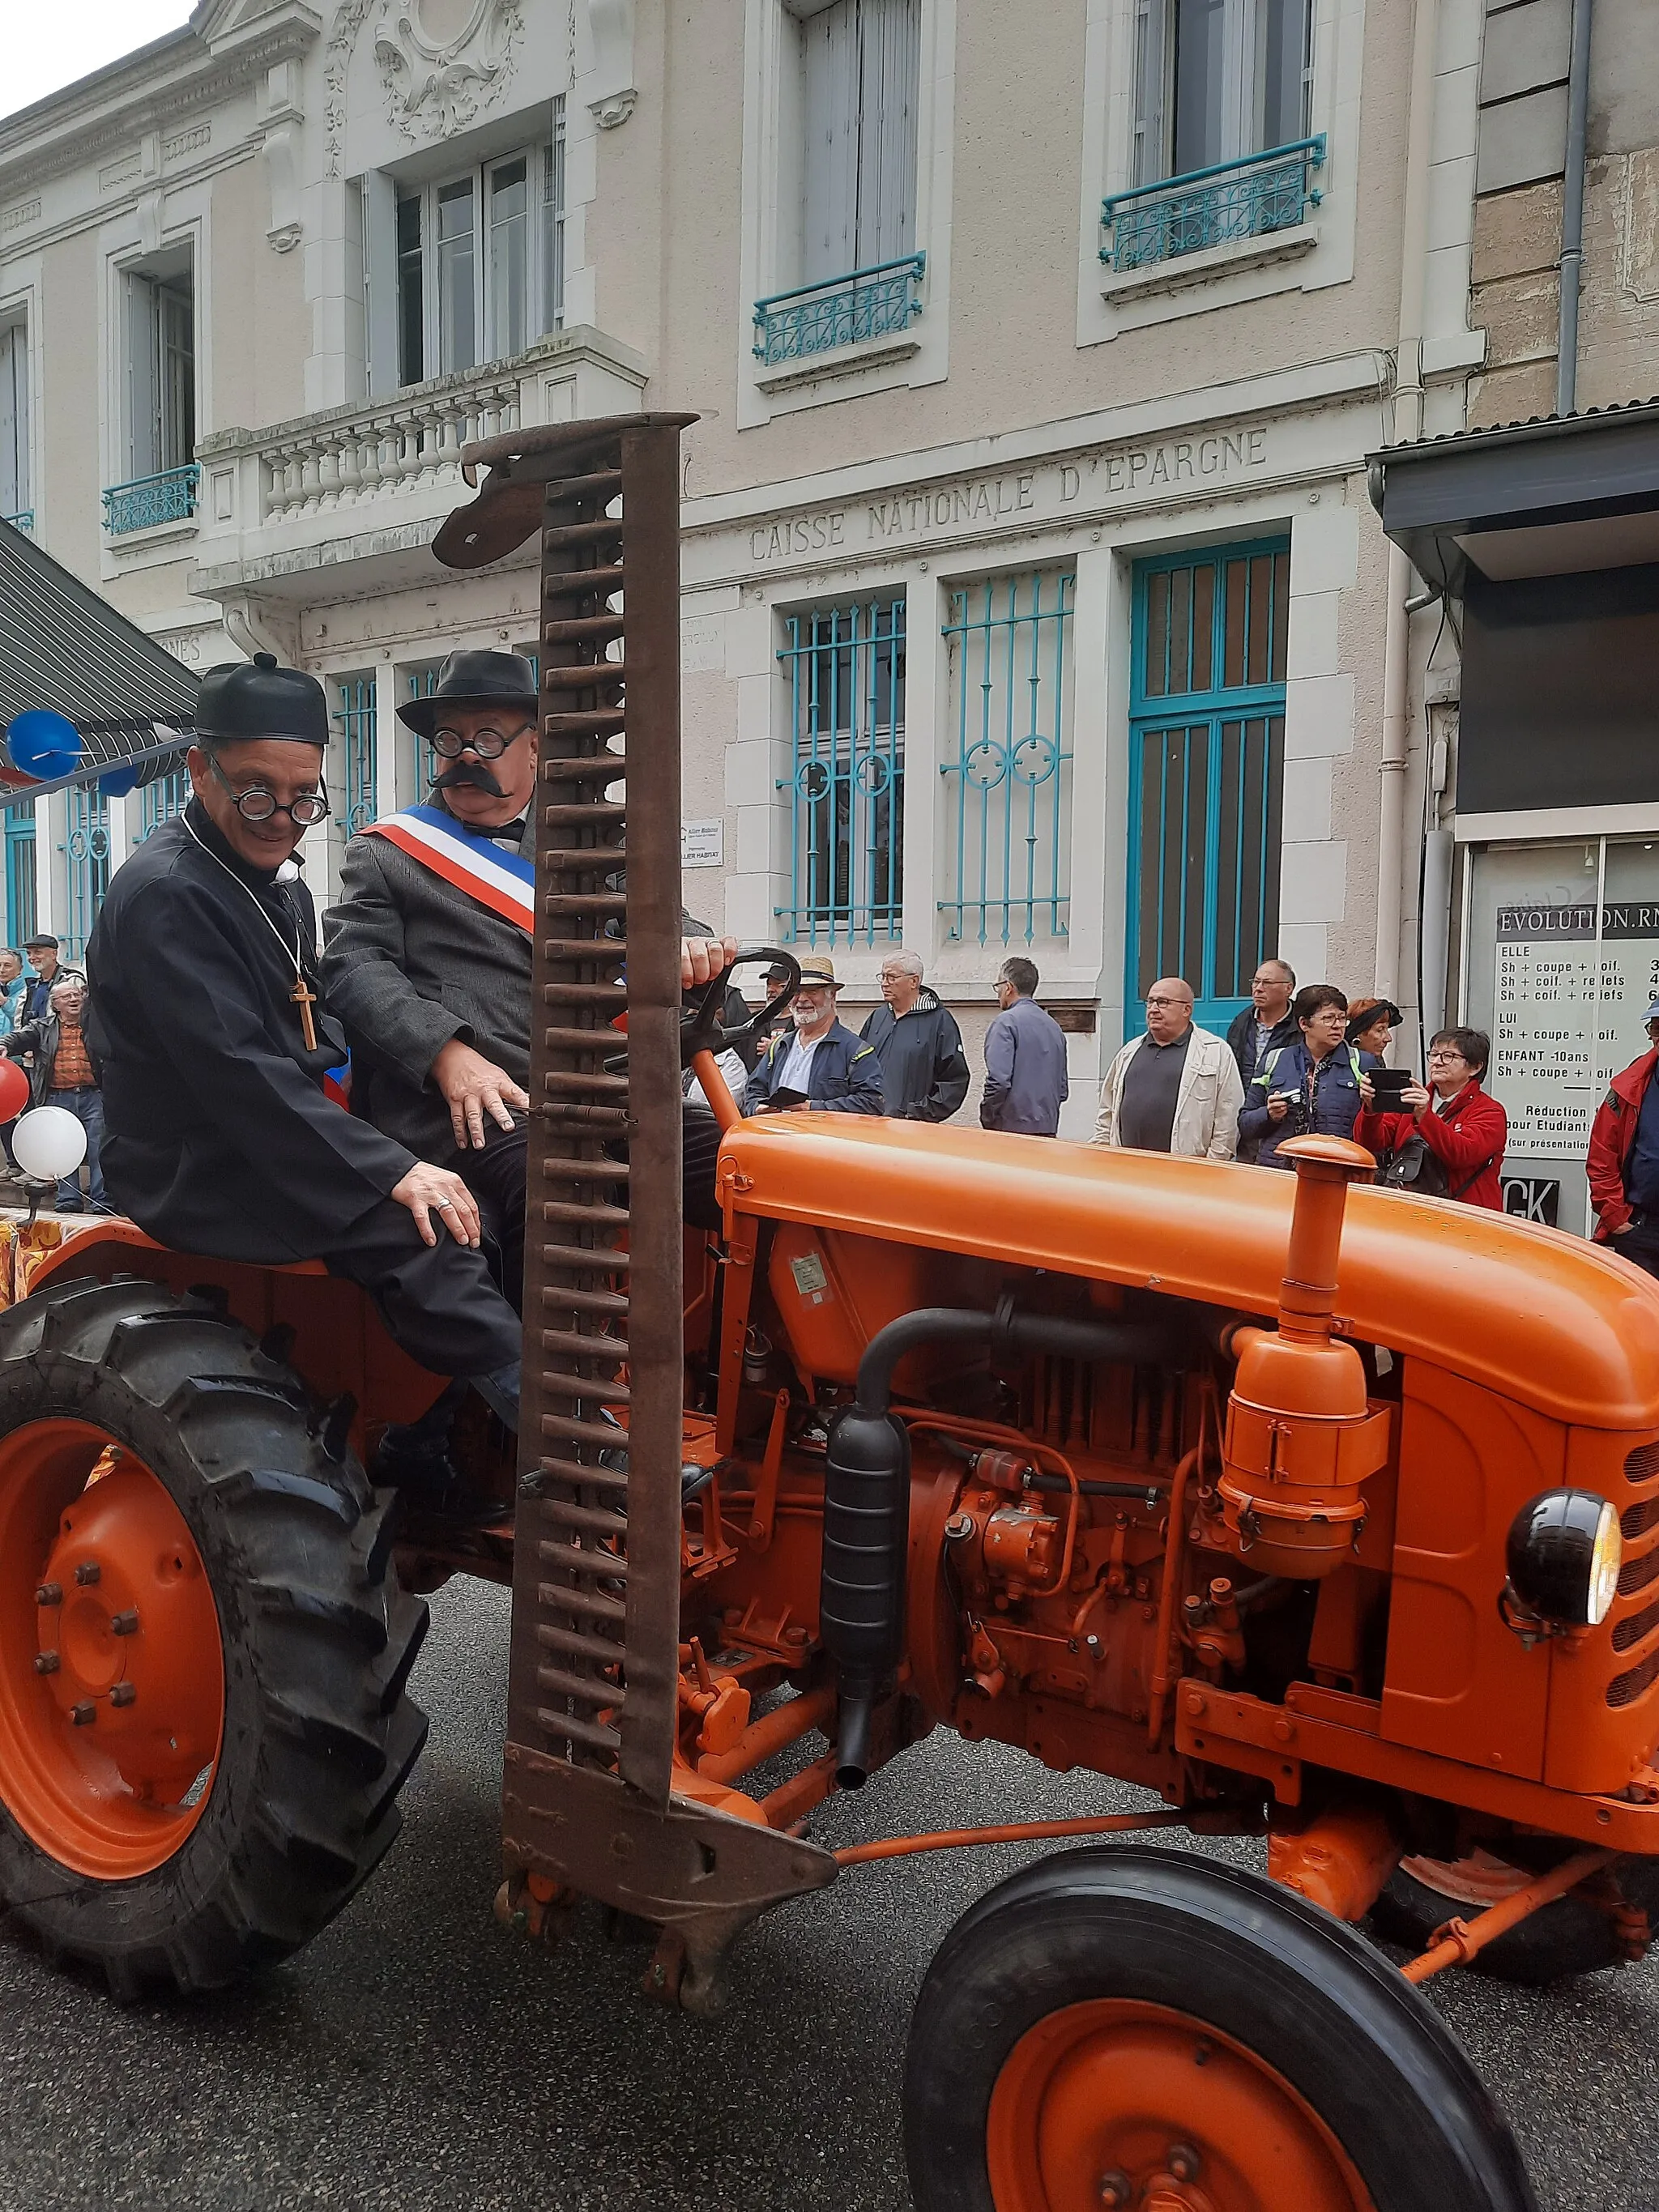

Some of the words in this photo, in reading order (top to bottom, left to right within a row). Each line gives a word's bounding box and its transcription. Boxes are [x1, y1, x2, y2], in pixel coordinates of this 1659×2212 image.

[750, 512, 845, 560] CAISSE
[867, 475, 1034, 539] NATIONALE
[1501, 946, 1530, 957] ELLE
[1501, 961, 1516, 973] Sh
[1521, 963, 1529, 972] +
[1536, 963, 1572, 974] coupe
[1578, 963, 1588, 971] +
[1500, 976, 1515, 987] Sh
[1520, 978, 1529, 987] +
[1536, 975, 1562, 987] coif.
[1567, 977, 1576, 986] +
[1583, 974, 1625, 986] relets
[1500, 990, 1514, 1001] Sh
[1520, 992, 1529, 1000] +
[1534, 990, 1560, 1000] coif.
[1567, 991, 1576, 1000] +
[1582, 989, 1623, 1000] reiefs
[1499, 1013, 1516, 1024] LUI
[1499, 1029, 1513, 1039] Sh
[1519, 1030, 1528, 1039] +
[1534, 1030, 1569, 1042] coupe
[1576, 1031, 1584, 1039] +
[1498, 1051, 1545, 1061] ENFANT
[1550, 1051, 1589, 1062] -10ans
[1498, 1066, 1512, 1076] Sh
[1517, 1068, 1526, 1076] +
[1533, 1068, 1568, 1079] coupe
[1574, 1069, 1583, 1077] +
[1589, 1068, 1614, 1079] oif
[1525, 1105, 1586, 1117] Réduction
[1508, 1138, 1527, 1148] (sur
